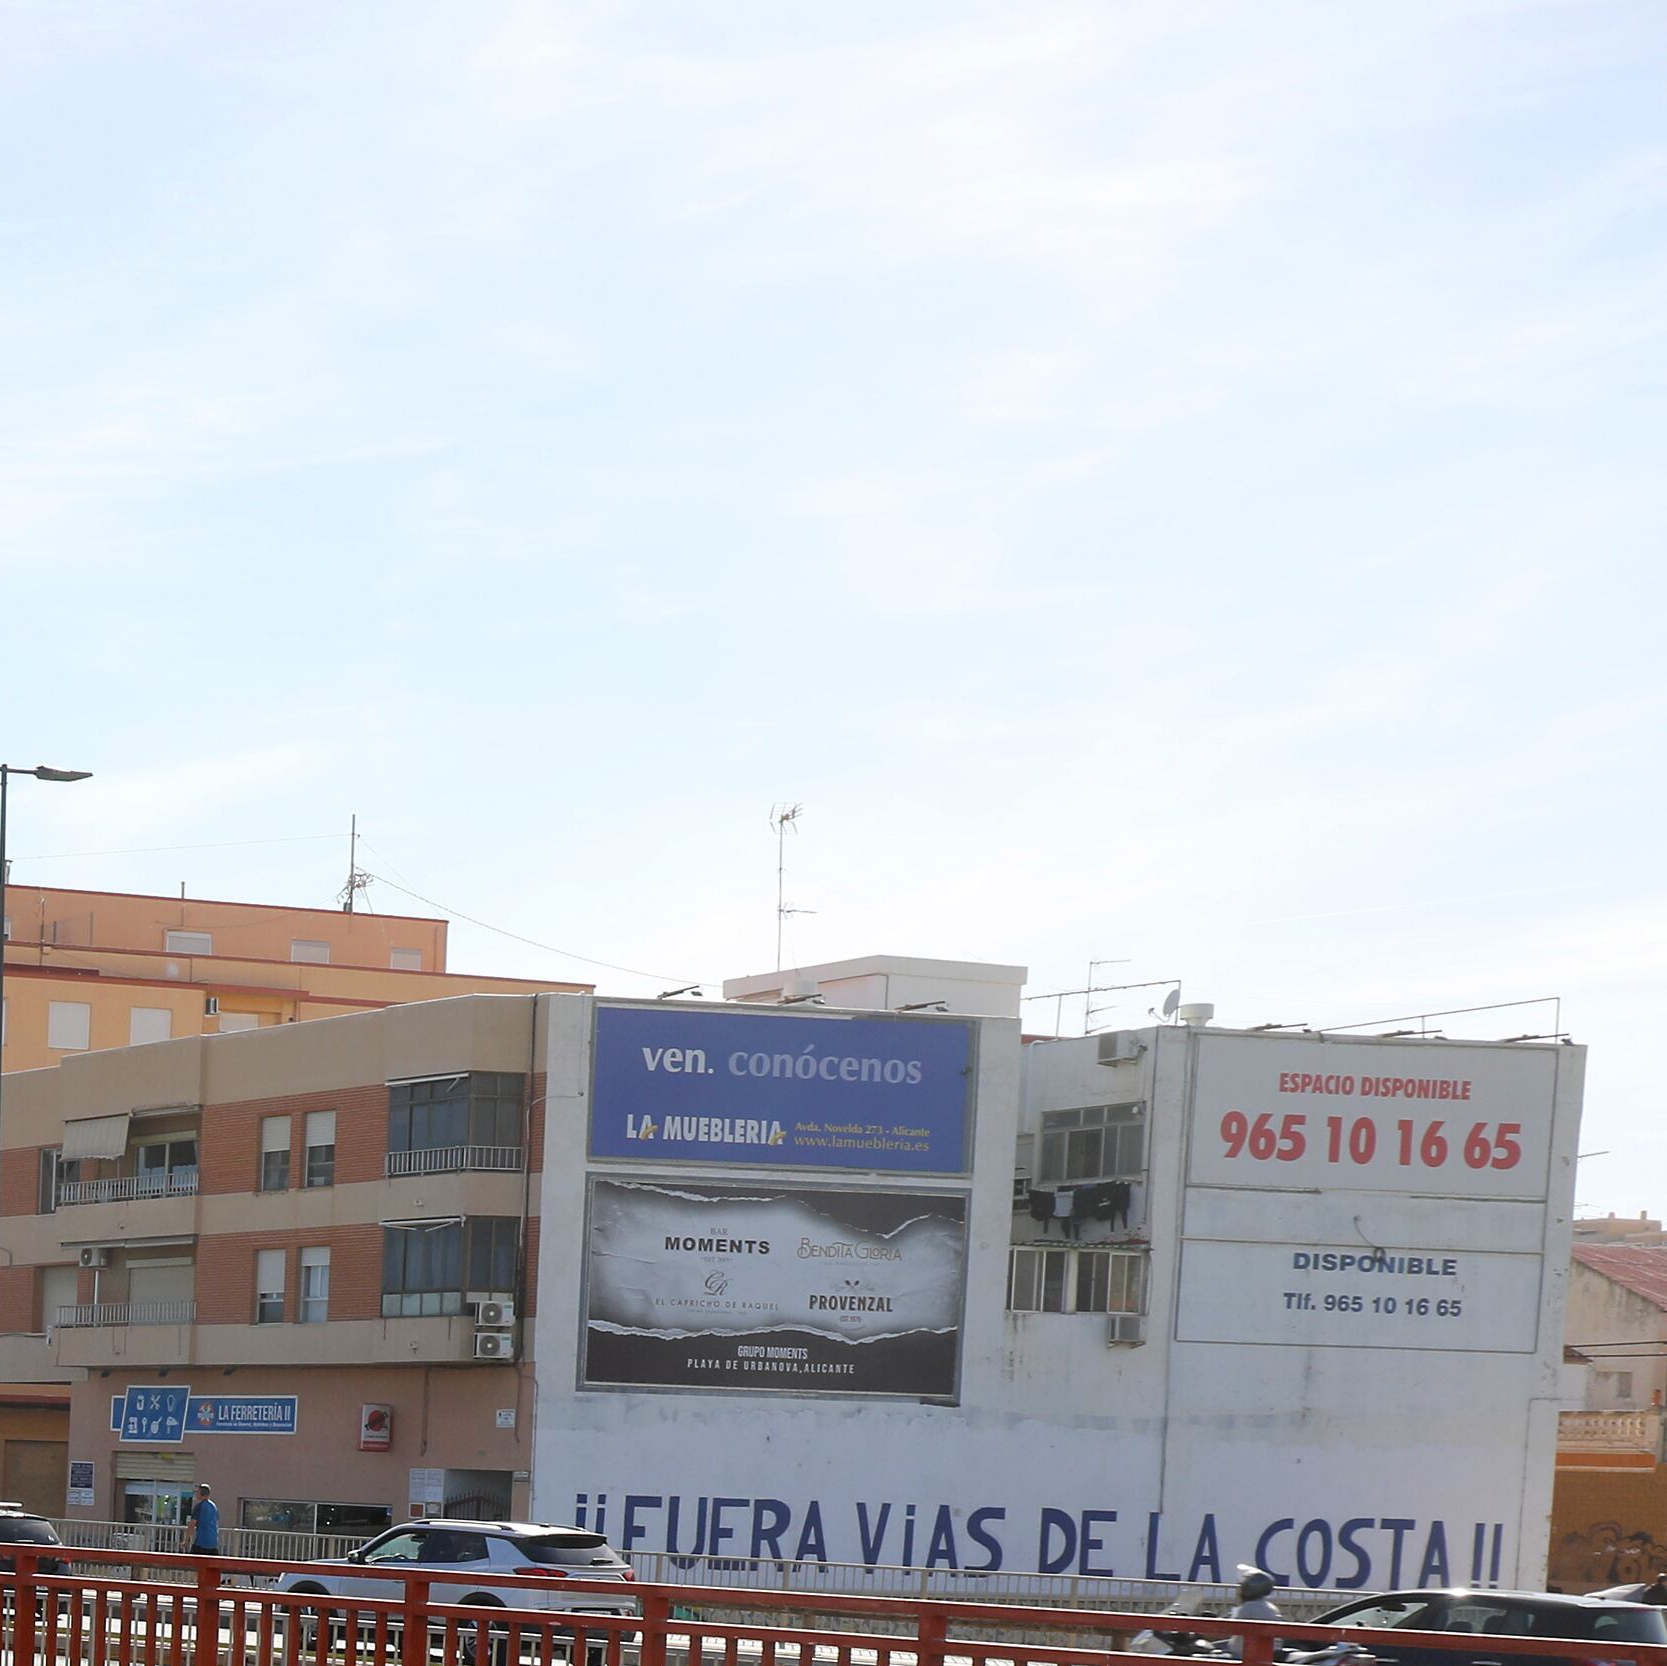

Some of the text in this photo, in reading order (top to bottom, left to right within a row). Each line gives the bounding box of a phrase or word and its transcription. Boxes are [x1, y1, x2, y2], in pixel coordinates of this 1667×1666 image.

[642, 1044, 922, 1084] ven. conócenos
[1279, 1072, 1472, 1101] ESPACIO DISPONIBLE
[626, 1114, 786, 1146] LA MUEBLERIA
[795, 1121, 821, 1132] Avda.
[825, 1123, 862, 1134] Novelda
[865, 1125, 883, 1135] 273
[892, 1126, 930, 1137] Alicante
[794, 1136, 930, 1152] www.lamuebleria.es
[1220, 1111, 1522, 1170] 965 10 16 65
[710, 1227, 728, 1236] BAR
[664, 1236, 770, 1255] MOMENTS
[1292, 1252, 1458, 1276] DISPONIBLE
[655, 1298, 779, 1311] EL CAPRICHO DE RAQUEL
[808, 1294, 894, 1312] PROVENZAL
[1283, 1292, 1463, 1318] Tlf. 965 10 16 65
[737, 1345, 808, 1360] GRUPO MOMENTS
[687, 1358, 720, 1369] PLAYA
[725, 1360, 738, 1370] DE
[218, 1402, 291, 1421] LA FERRETERÍA II
[1038, 1508, 1118, 1578] DE
[1146, 1511, 1222, 1584] LA
